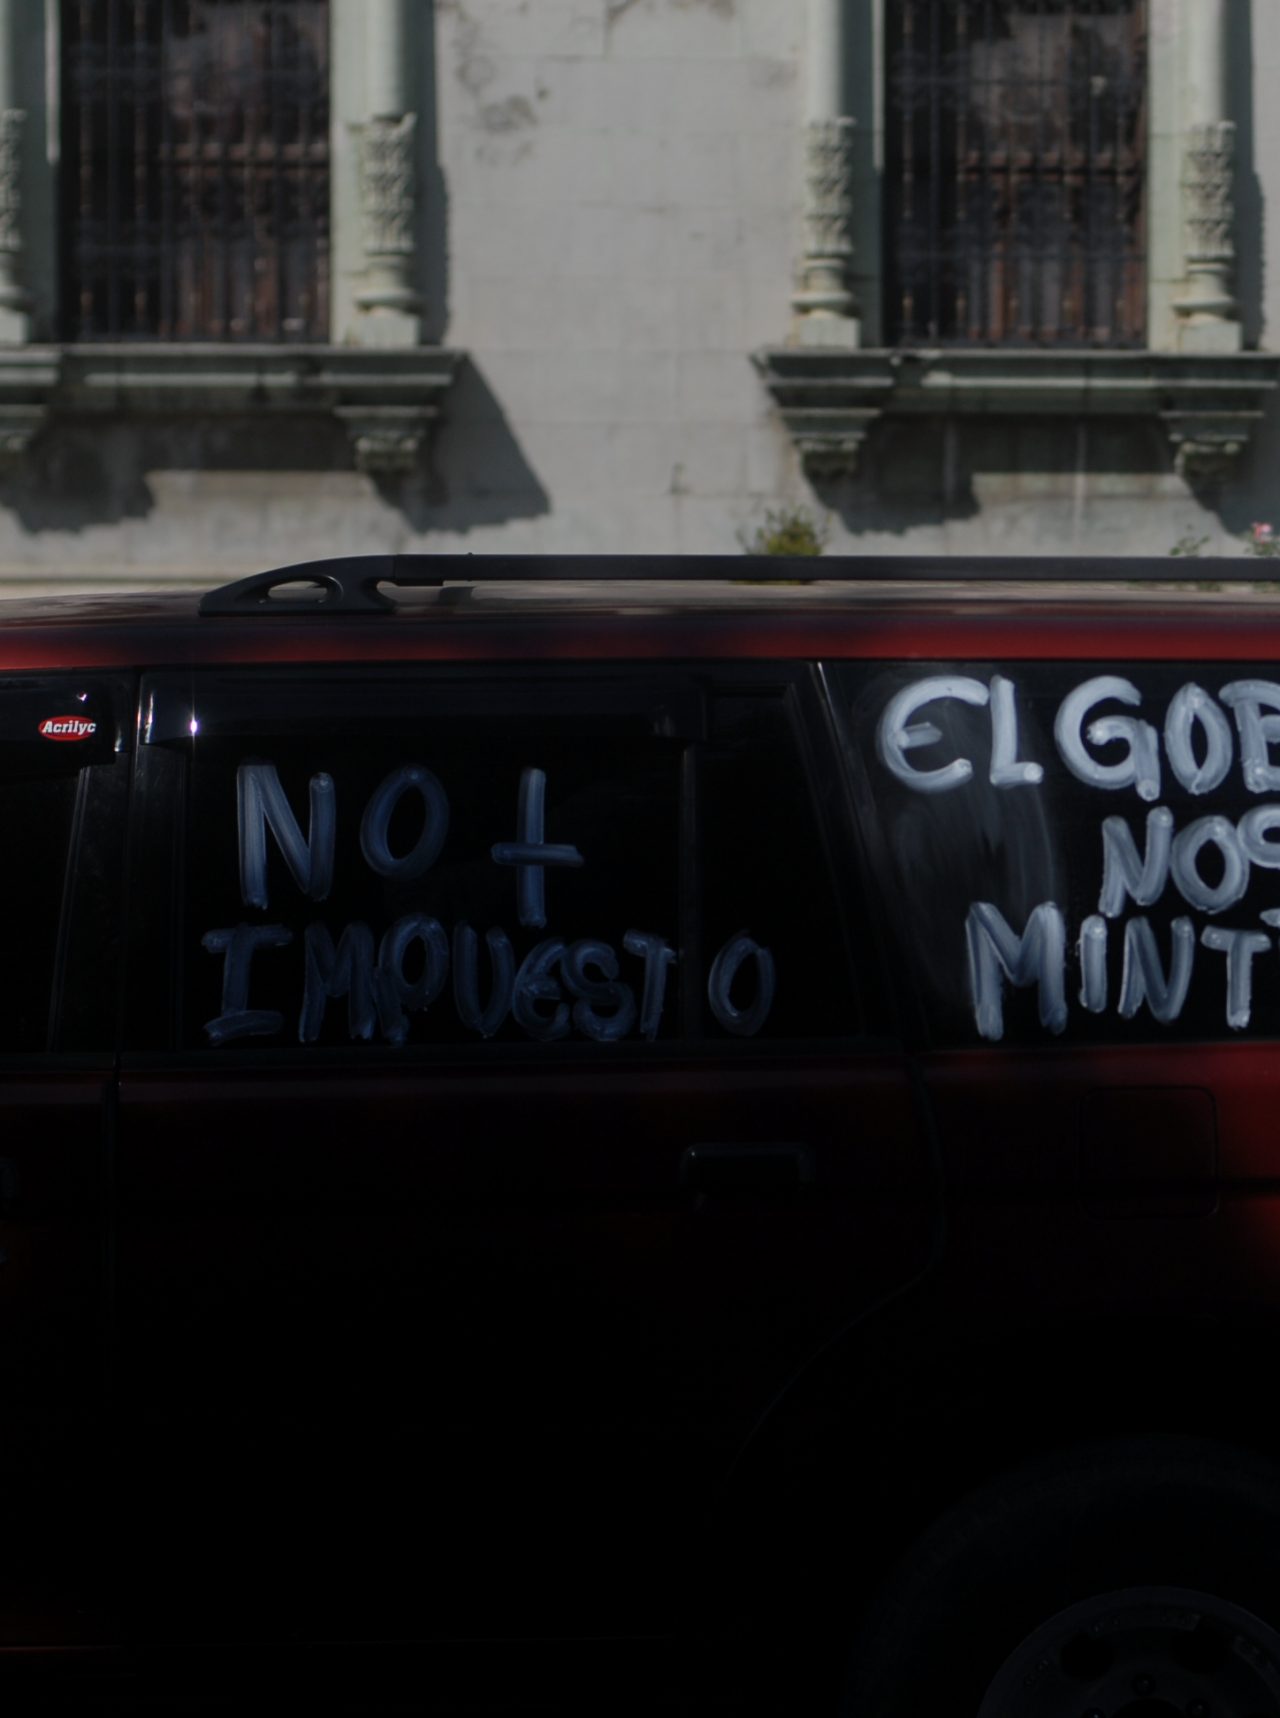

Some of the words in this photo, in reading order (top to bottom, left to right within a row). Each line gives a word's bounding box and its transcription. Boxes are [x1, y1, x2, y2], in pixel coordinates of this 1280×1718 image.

[41, 720, 96, 736] Acrilyc
[877, 674, 1044, 792] EL
[236, 759, 451, 910] NO
